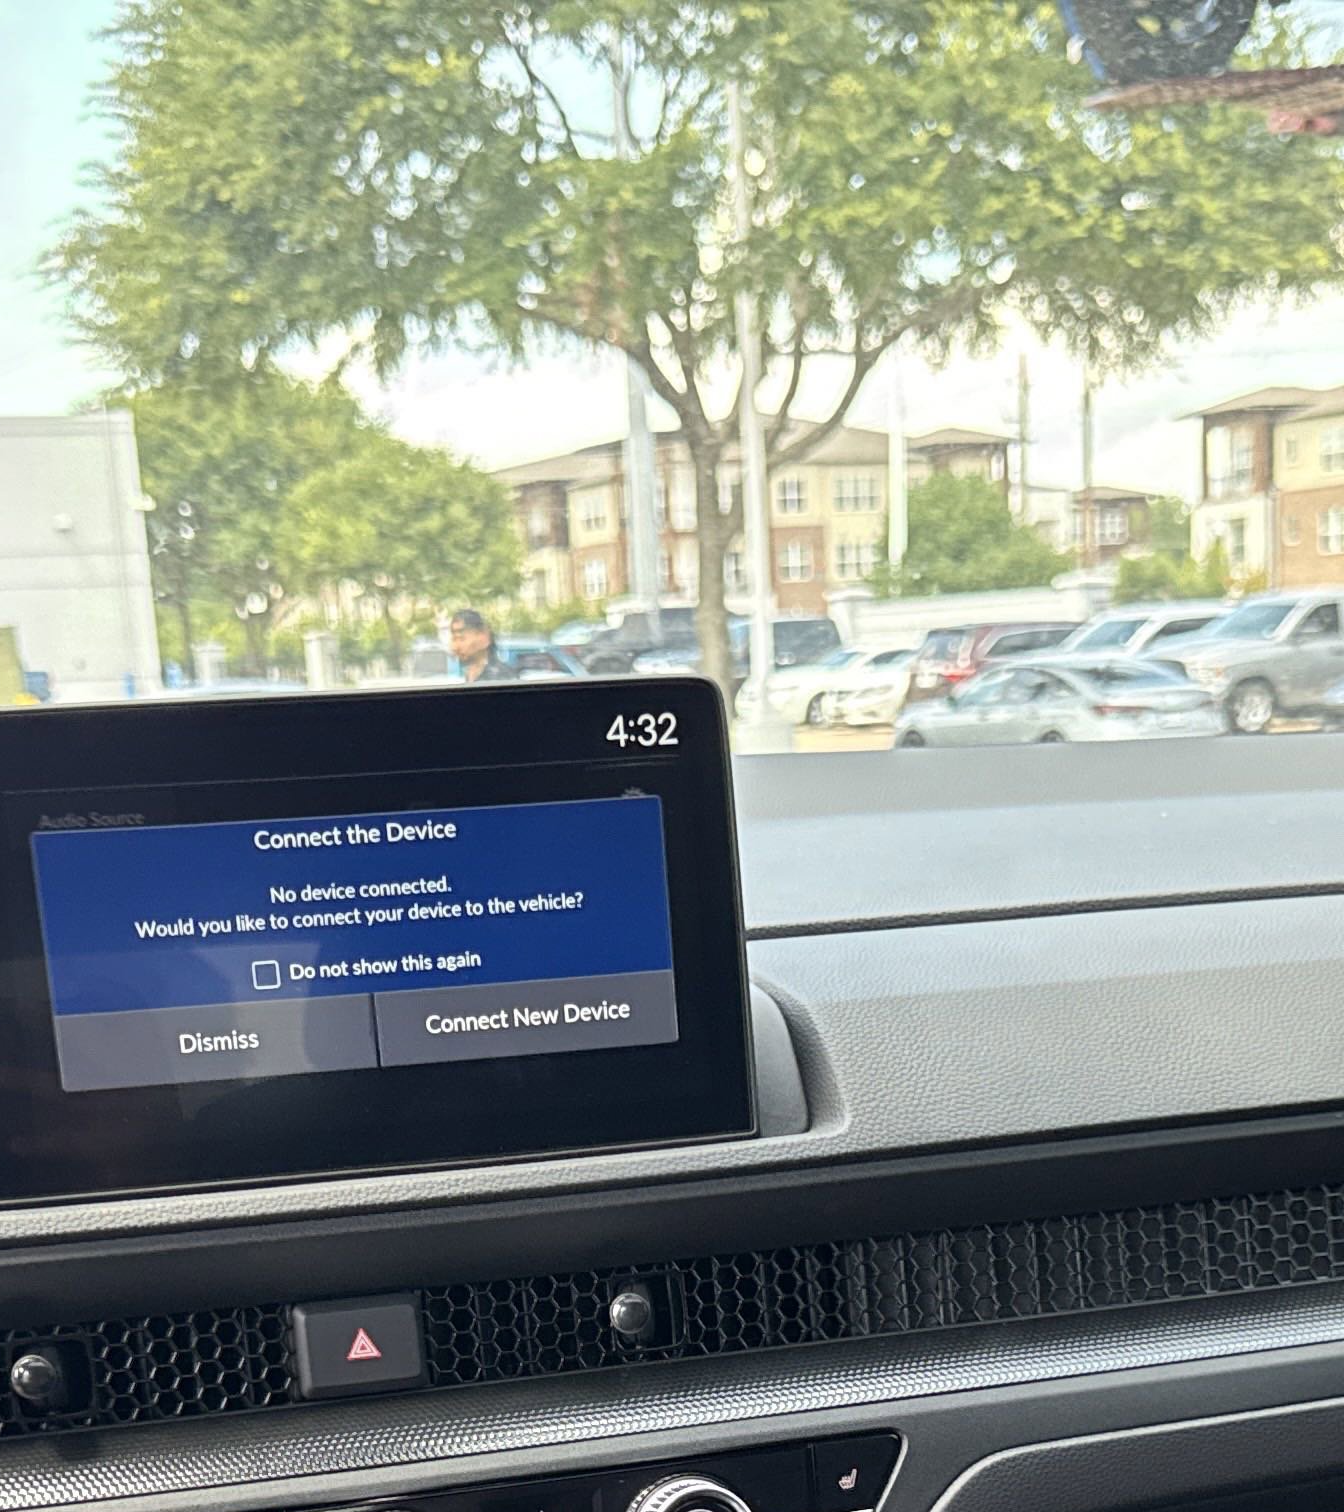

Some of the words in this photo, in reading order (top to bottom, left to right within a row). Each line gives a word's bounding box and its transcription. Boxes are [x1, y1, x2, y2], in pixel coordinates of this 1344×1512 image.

[605, 711, 679, 748] 4:32
[254, 827, 342, 851] Connect
[346, 824, 380, 845] the
[386, 820, 456, 843] Device
[270, 885, 297, 905] No
[301, 882, 356, 902] device
[359, 876, 452, 899] connected.
[135, 918, 195, 939] Would
[199, 919, 232, 938] you
[236, 913, 266, 933] like
[269, 914, 288, 931] to
[292, 909, 361, 929] connect
[365, 907, 405, 927] your
[408, 901, 462, 922] device
[465, 901, 484, 917] to
[488, 896, 515, 915] the
[518, 891, 584, 913] vehicle?
[289, 963, 316, 982] Do
[320, 961, 349, 979] not
[353, 956, 397, 976] show
[401, 954, 433, 973] this
[436, 951, 482, 972] again
[425, 1010, 509, 1035] Connect
[514, 1008, 558, 1028] New
[564, 1001, 631, 1025] Device
[179, 1031, 260, 1055] Dismiss
